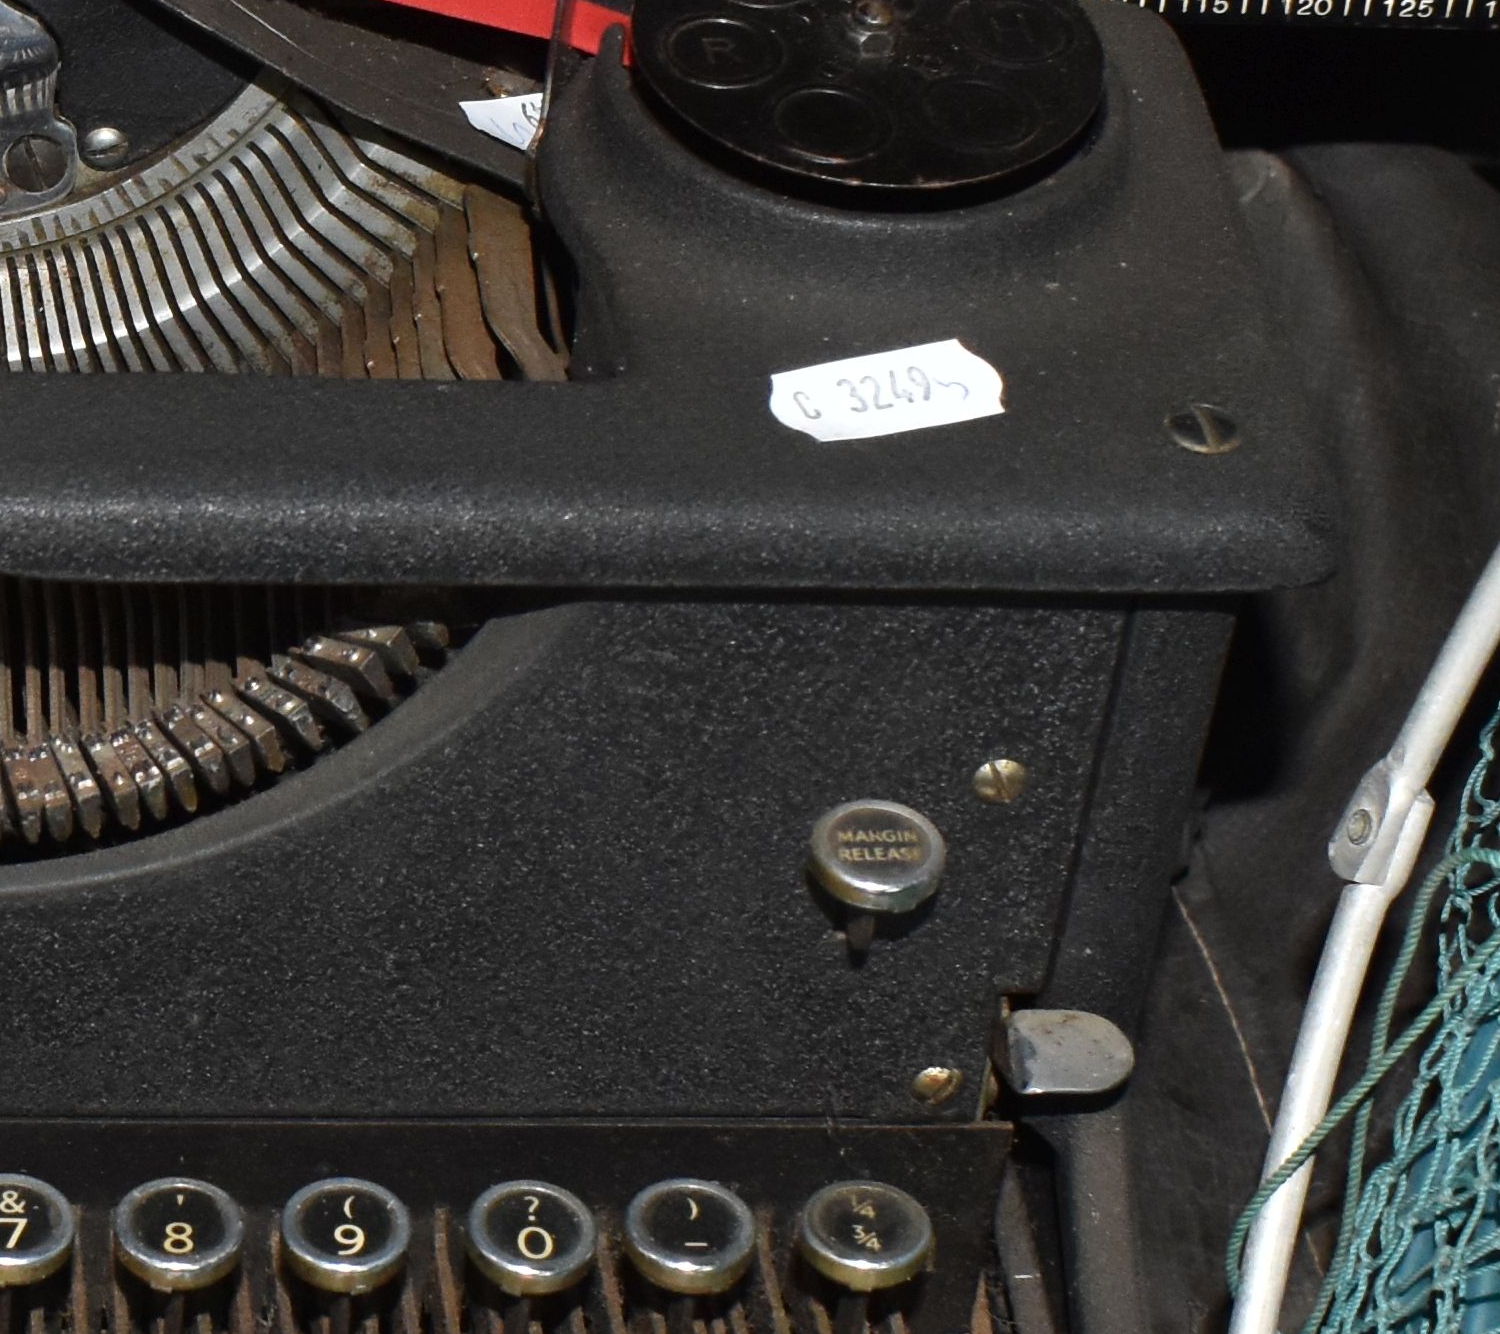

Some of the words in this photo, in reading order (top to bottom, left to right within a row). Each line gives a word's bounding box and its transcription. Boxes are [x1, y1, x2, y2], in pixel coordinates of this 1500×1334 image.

[1384, 0, 1434, 19] 125
[837, 829, 919, 844] MARGIN
[0, 1190, 26, 1213] &
[524, 1197, 541, 1221] ?
[5, 1219, 28, 1248] 7
[163, 1222, 194, 1255] 8
[334, 1224, 365, 1256] 9
